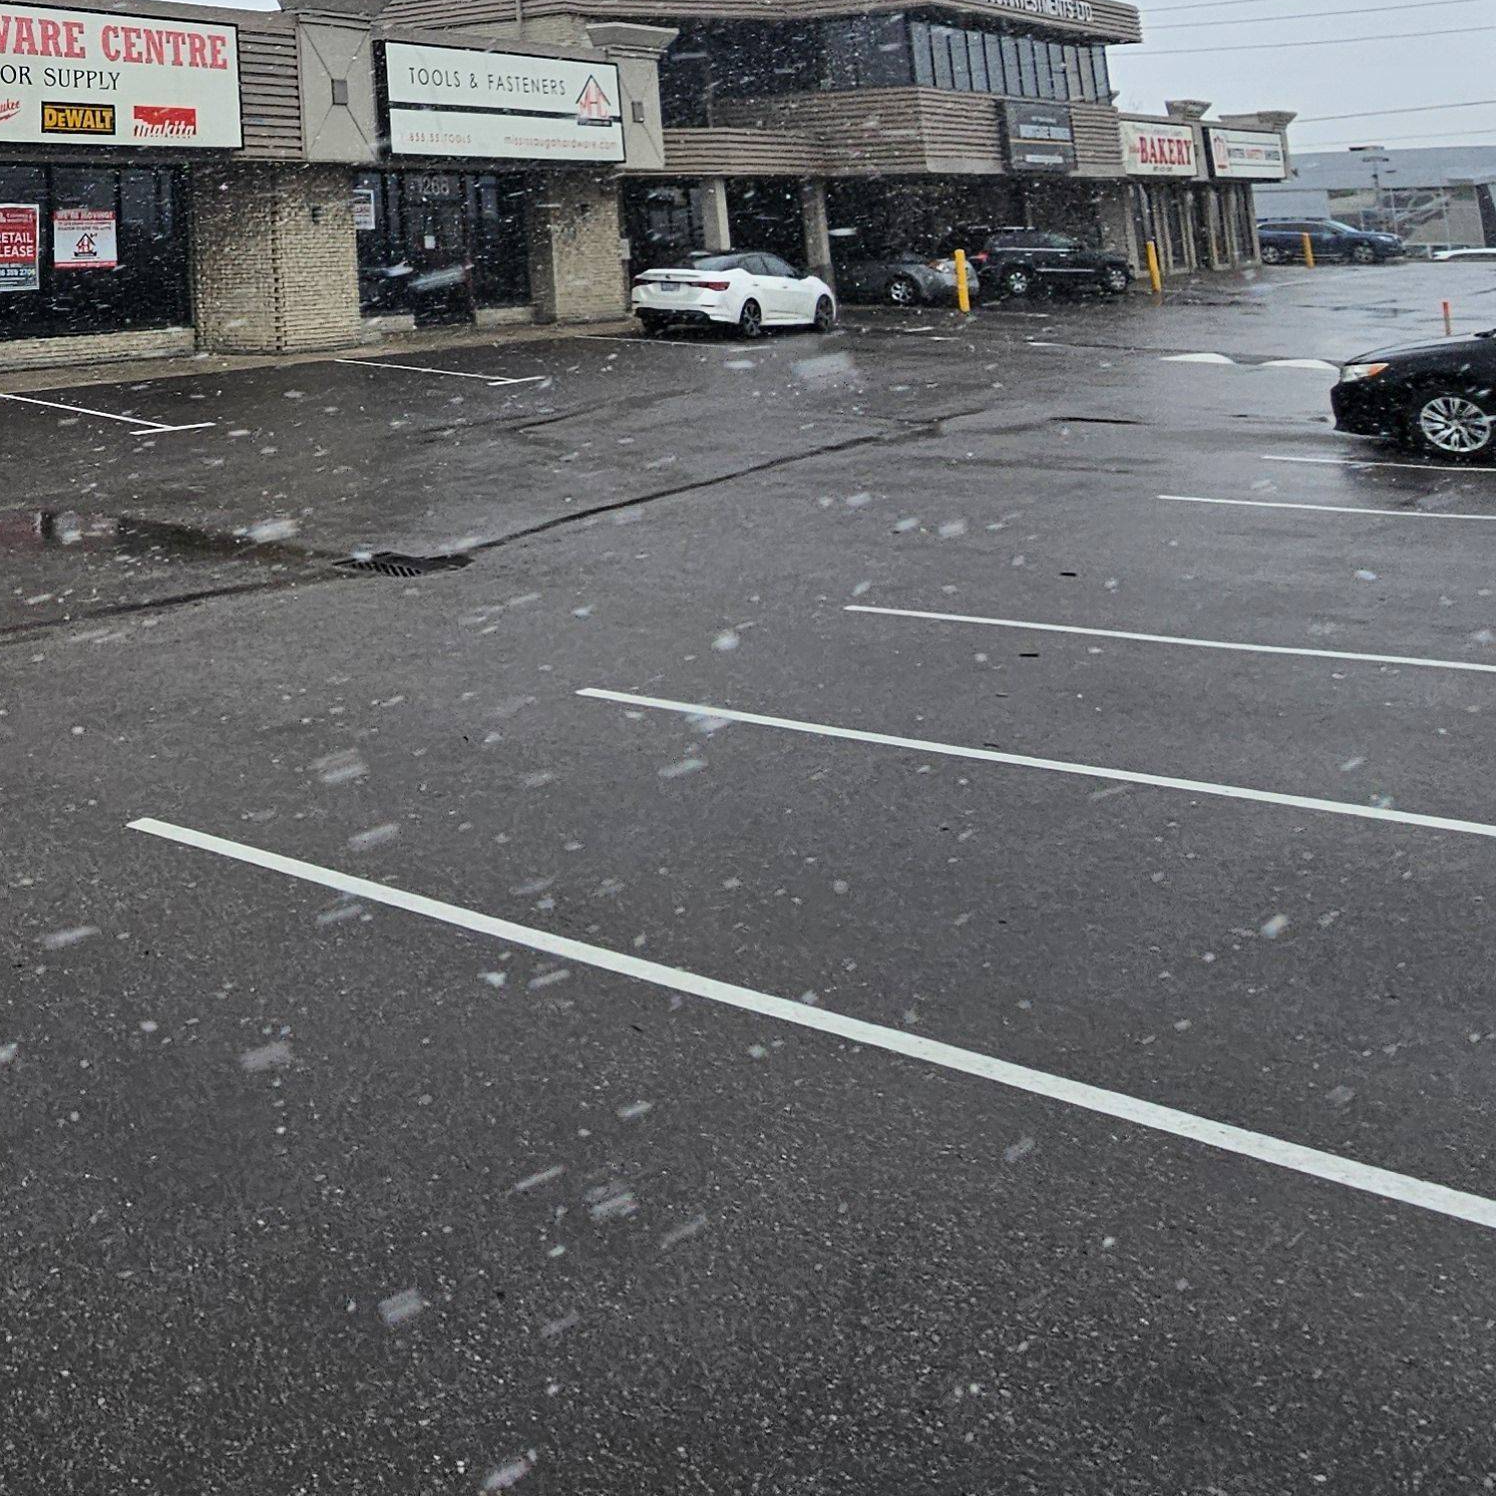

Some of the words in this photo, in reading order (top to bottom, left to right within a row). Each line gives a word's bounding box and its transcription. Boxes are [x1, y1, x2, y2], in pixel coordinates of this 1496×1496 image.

[100, 24, 229, 70] CENTRE
[43, 68, 121, 91] SUPPLY
[409, 67, 461, 88] TOOLS
[470, 73, 479, 89] &
[488, 74, 567, 96] FASTENERS
[1139, 136, 1193, 166] BAKERY
